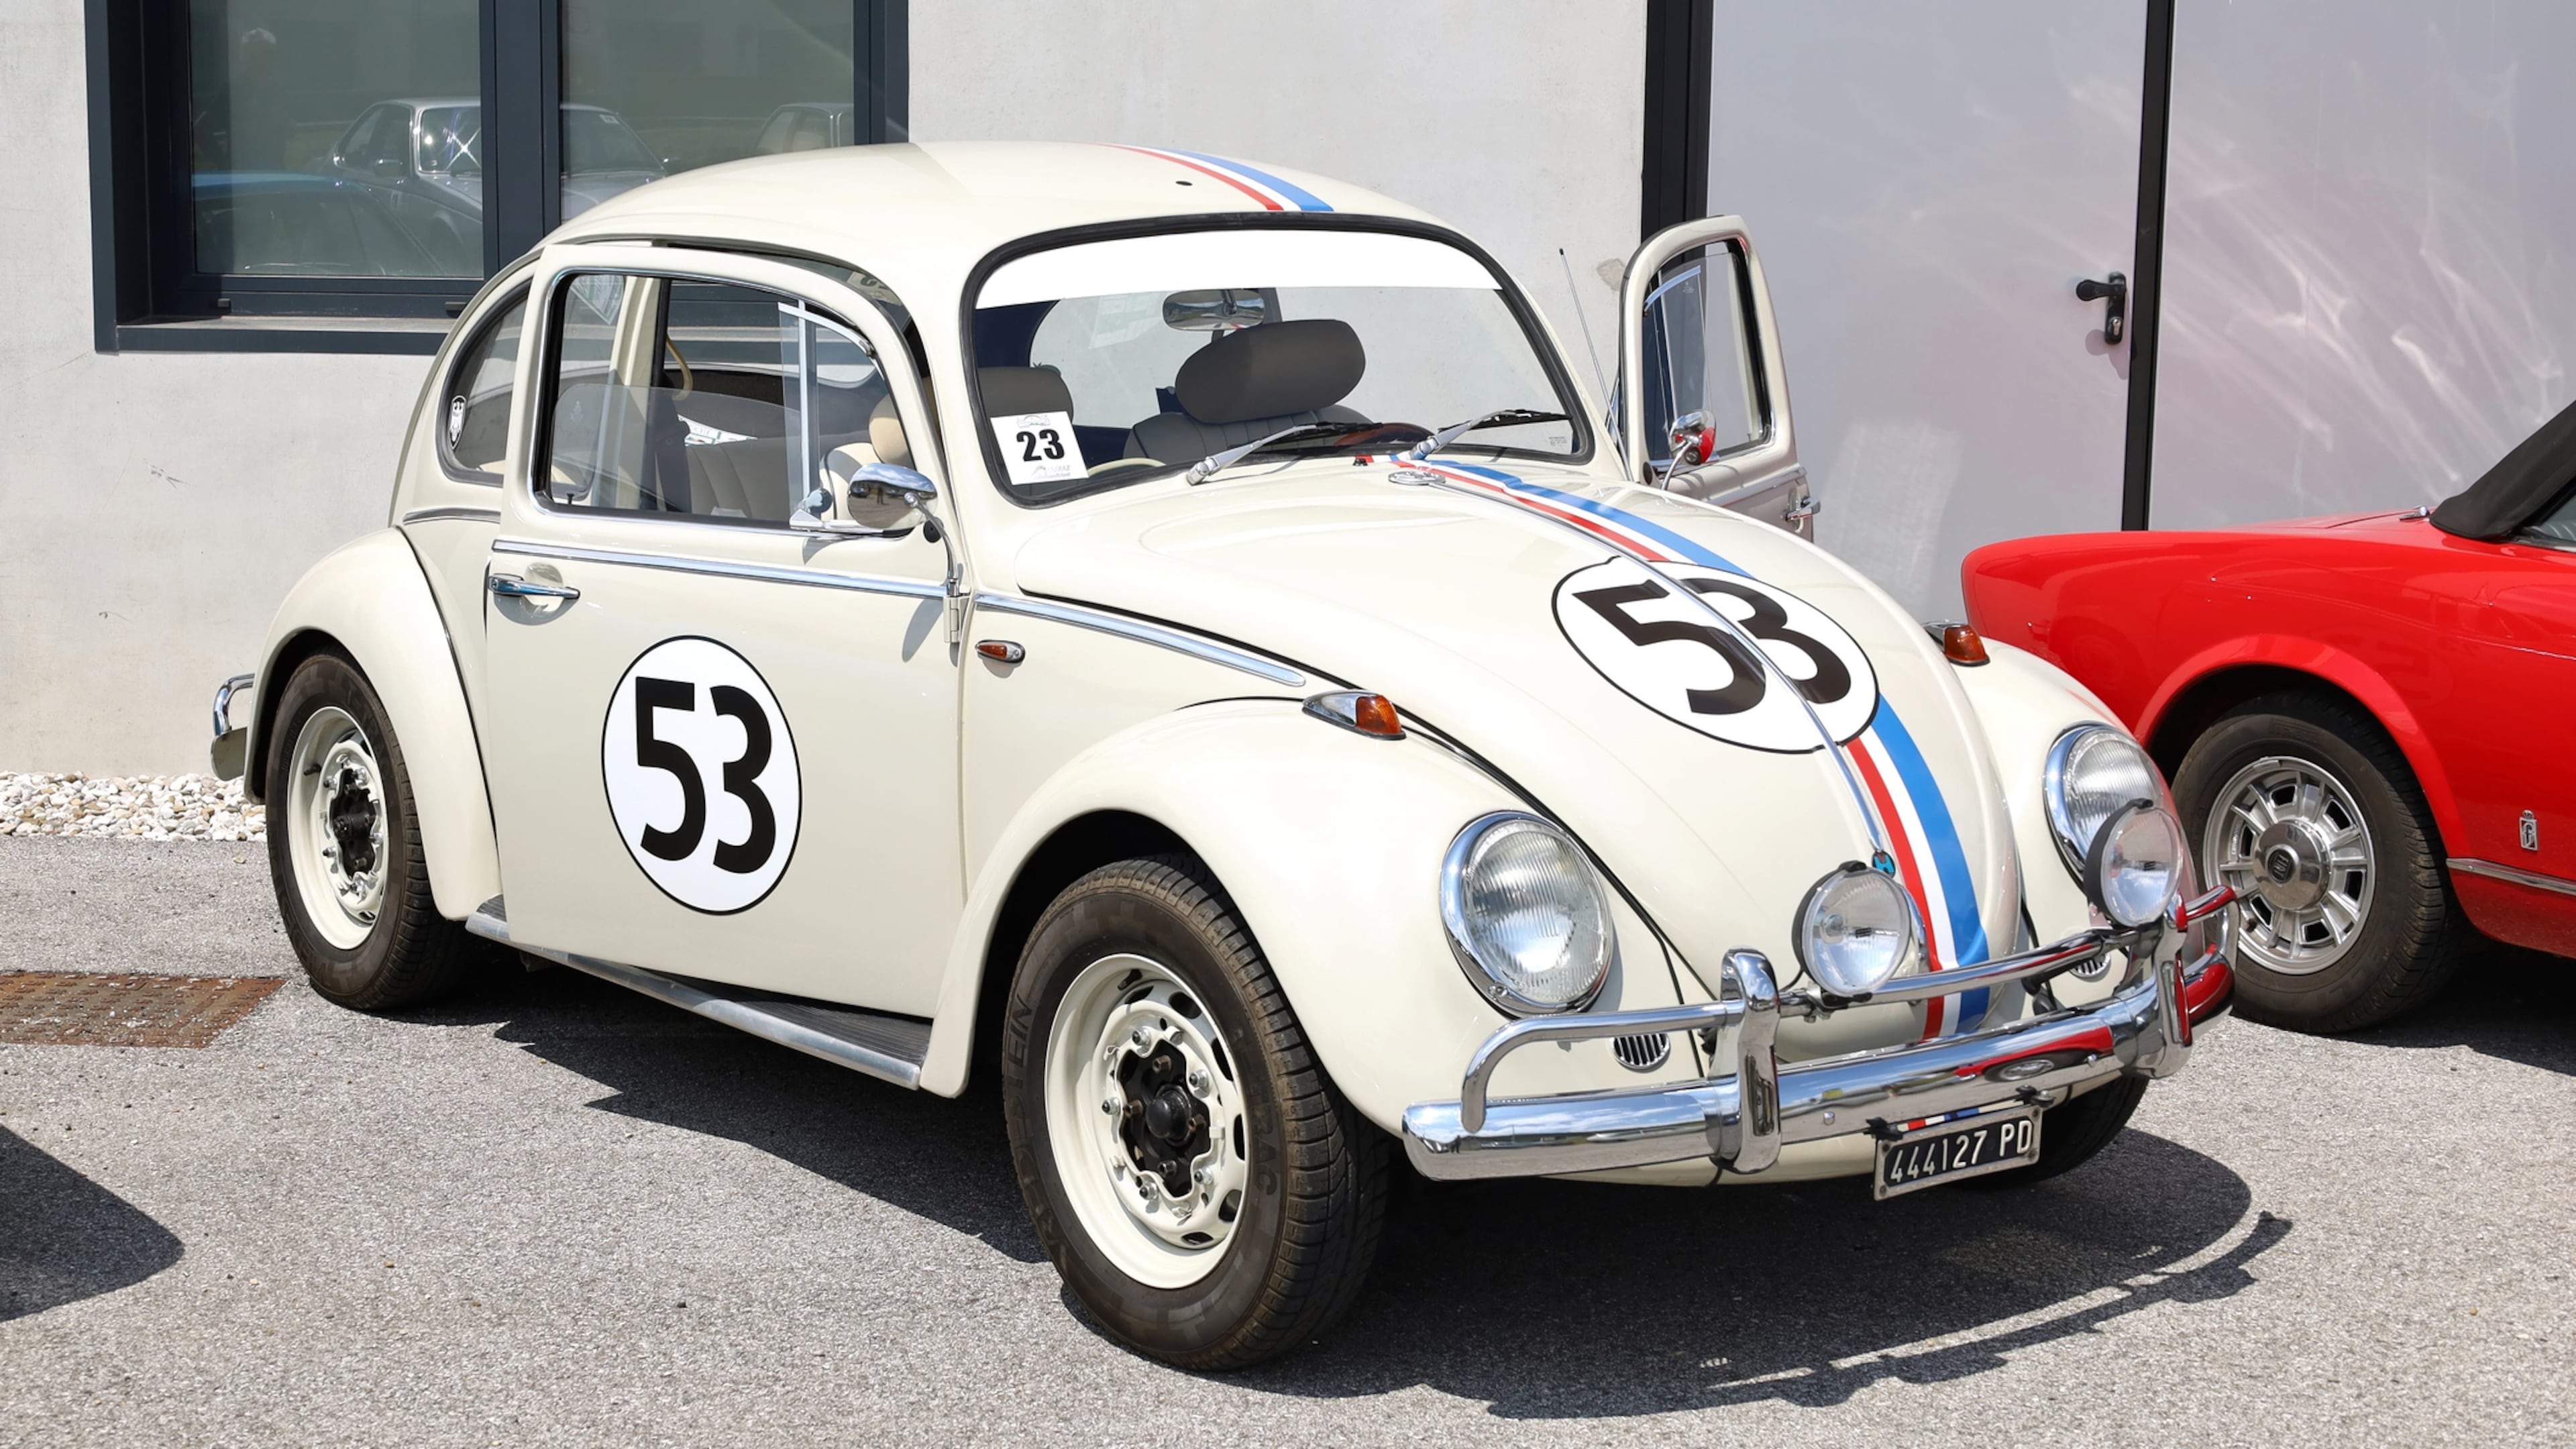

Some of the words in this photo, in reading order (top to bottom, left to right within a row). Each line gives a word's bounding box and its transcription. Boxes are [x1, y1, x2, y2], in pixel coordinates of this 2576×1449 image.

[1016, 429, 1065, 462] 23
[1572, 578, 1851, 715] 53
[635, 676, 776, 874] 53
[1890, 1130, 1988, 1183] 444127
[2000, 1120, 2033, 1157] PD
